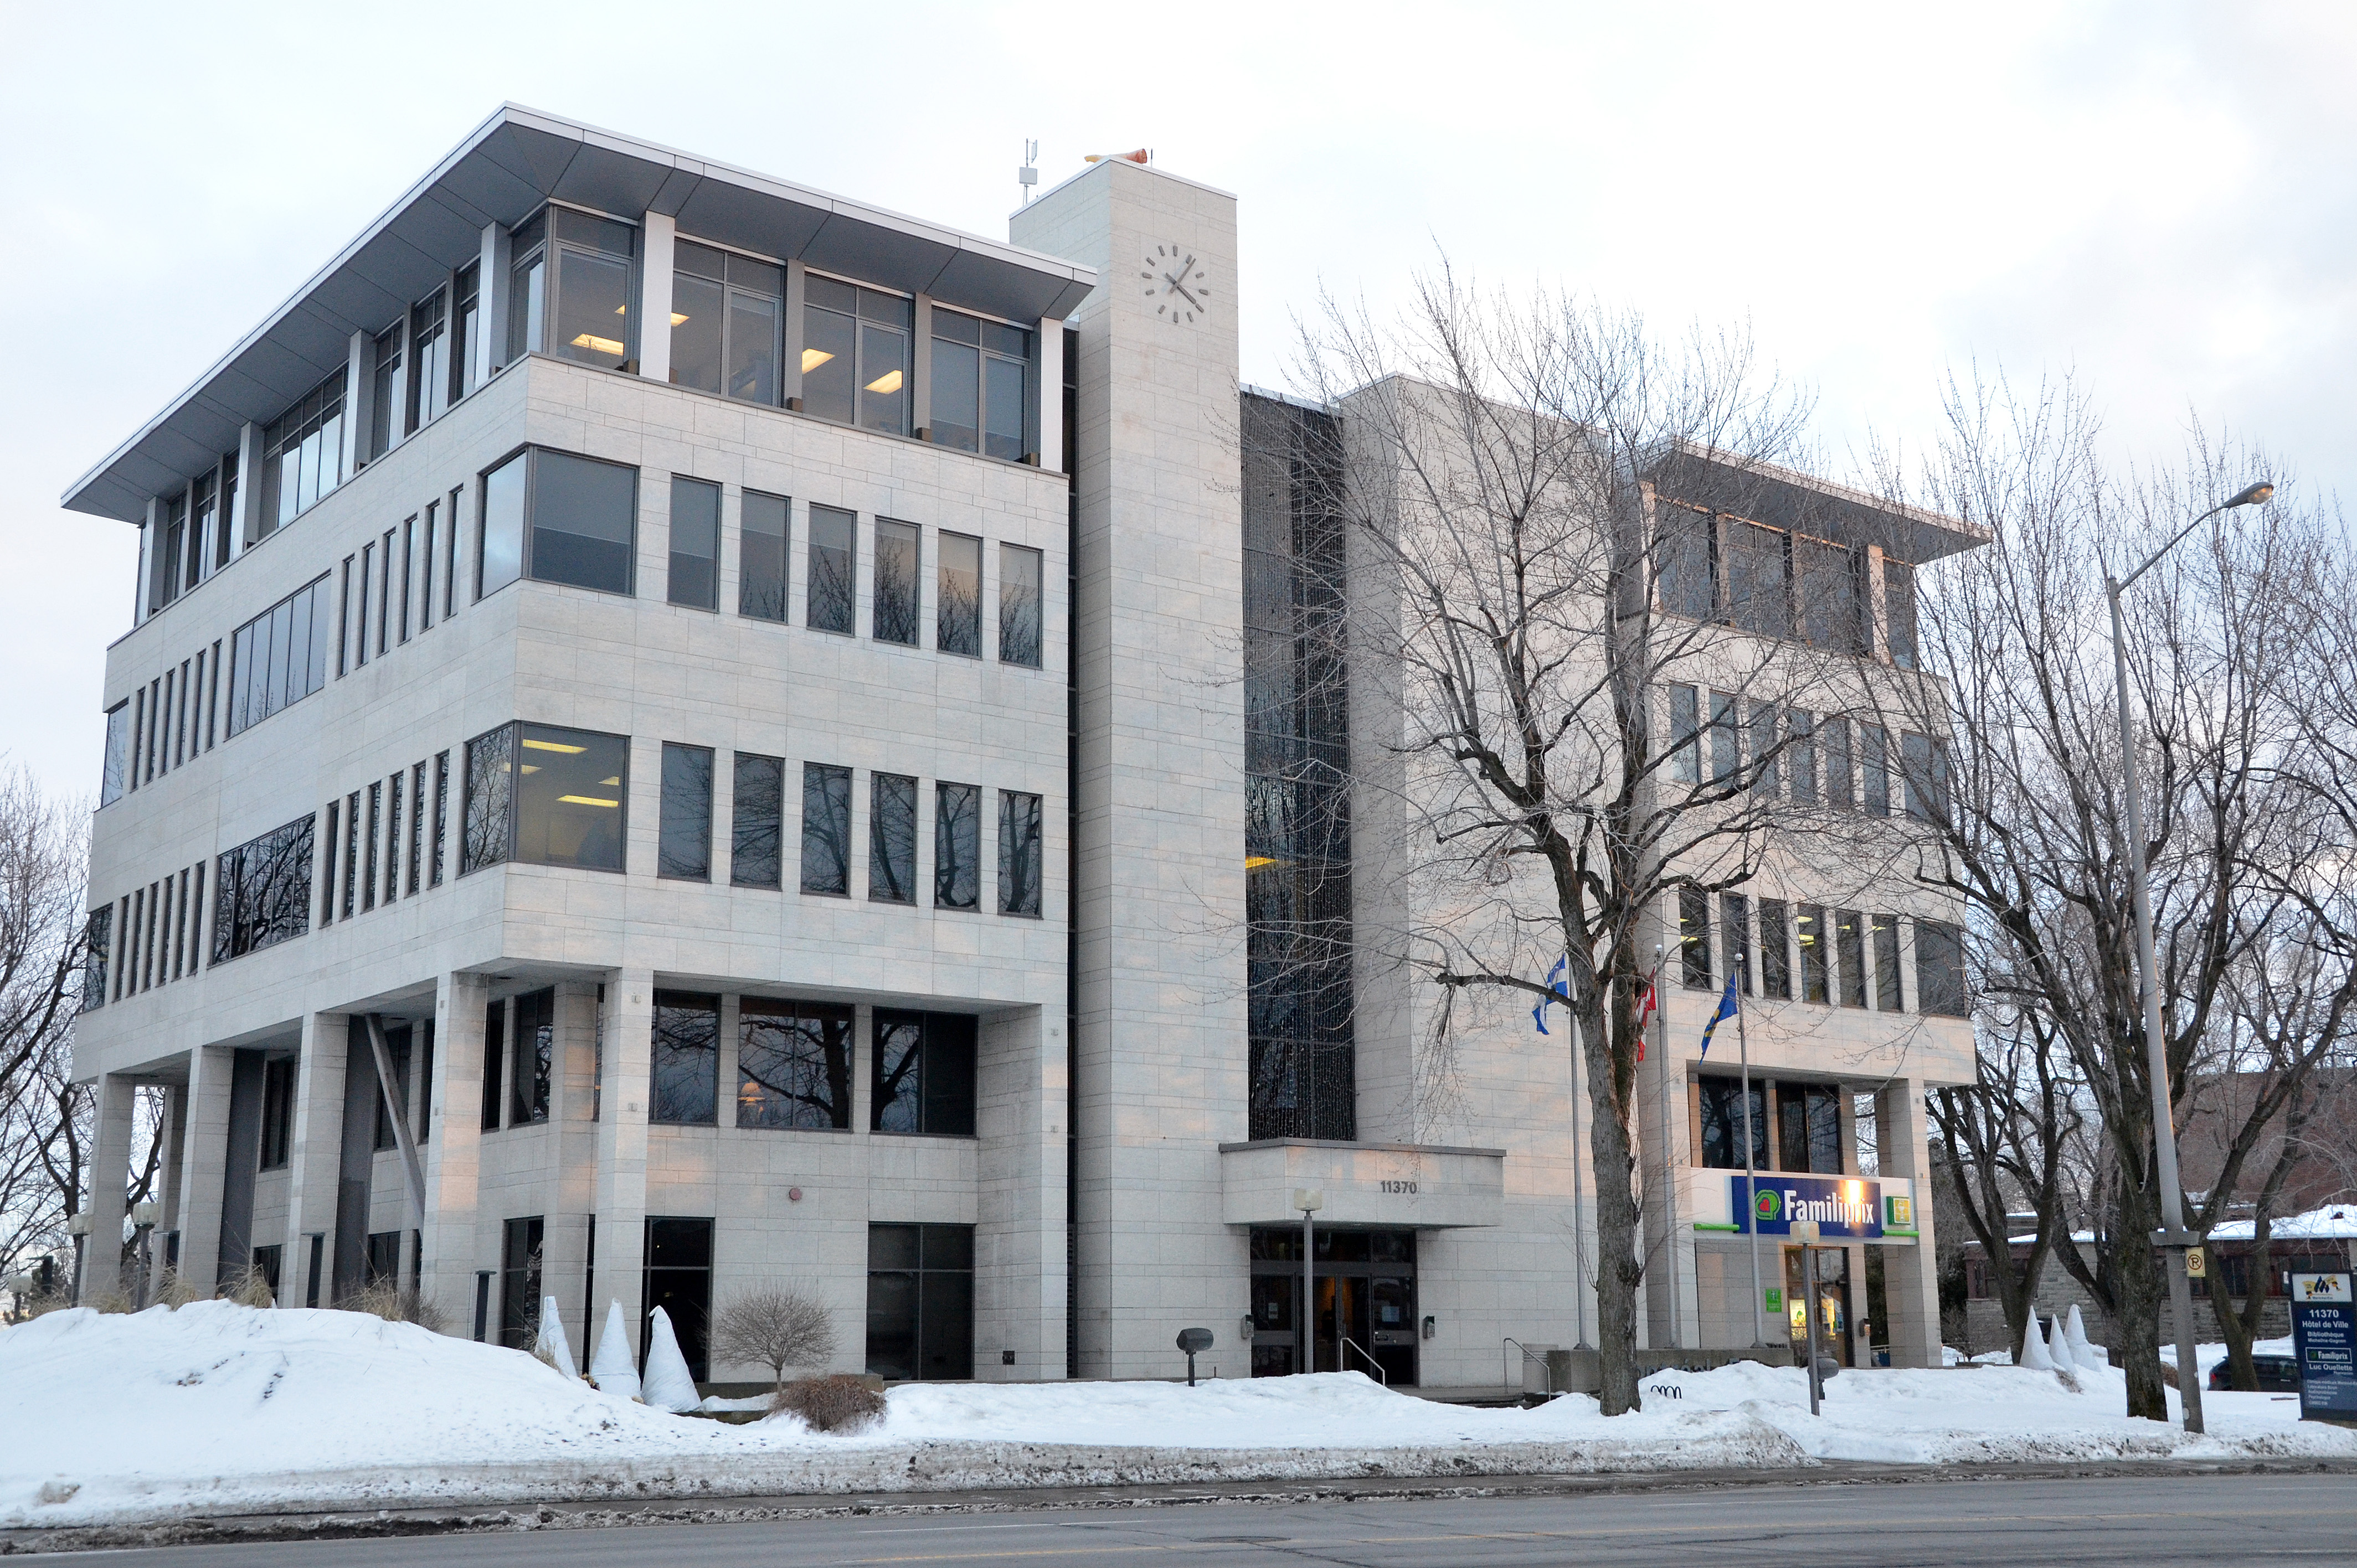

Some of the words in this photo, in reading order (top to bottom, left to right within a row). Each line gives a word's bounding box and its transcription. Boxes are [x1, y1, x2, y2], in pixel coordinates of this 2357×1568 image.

[1381, 1180, 1417, 1194] 11370
[1784, 1190, 1875, 1229] Familiprix
[2309, 1309, 2339, 1318] 11370
[2318, 1351, 2348, 1361] Familiprix
